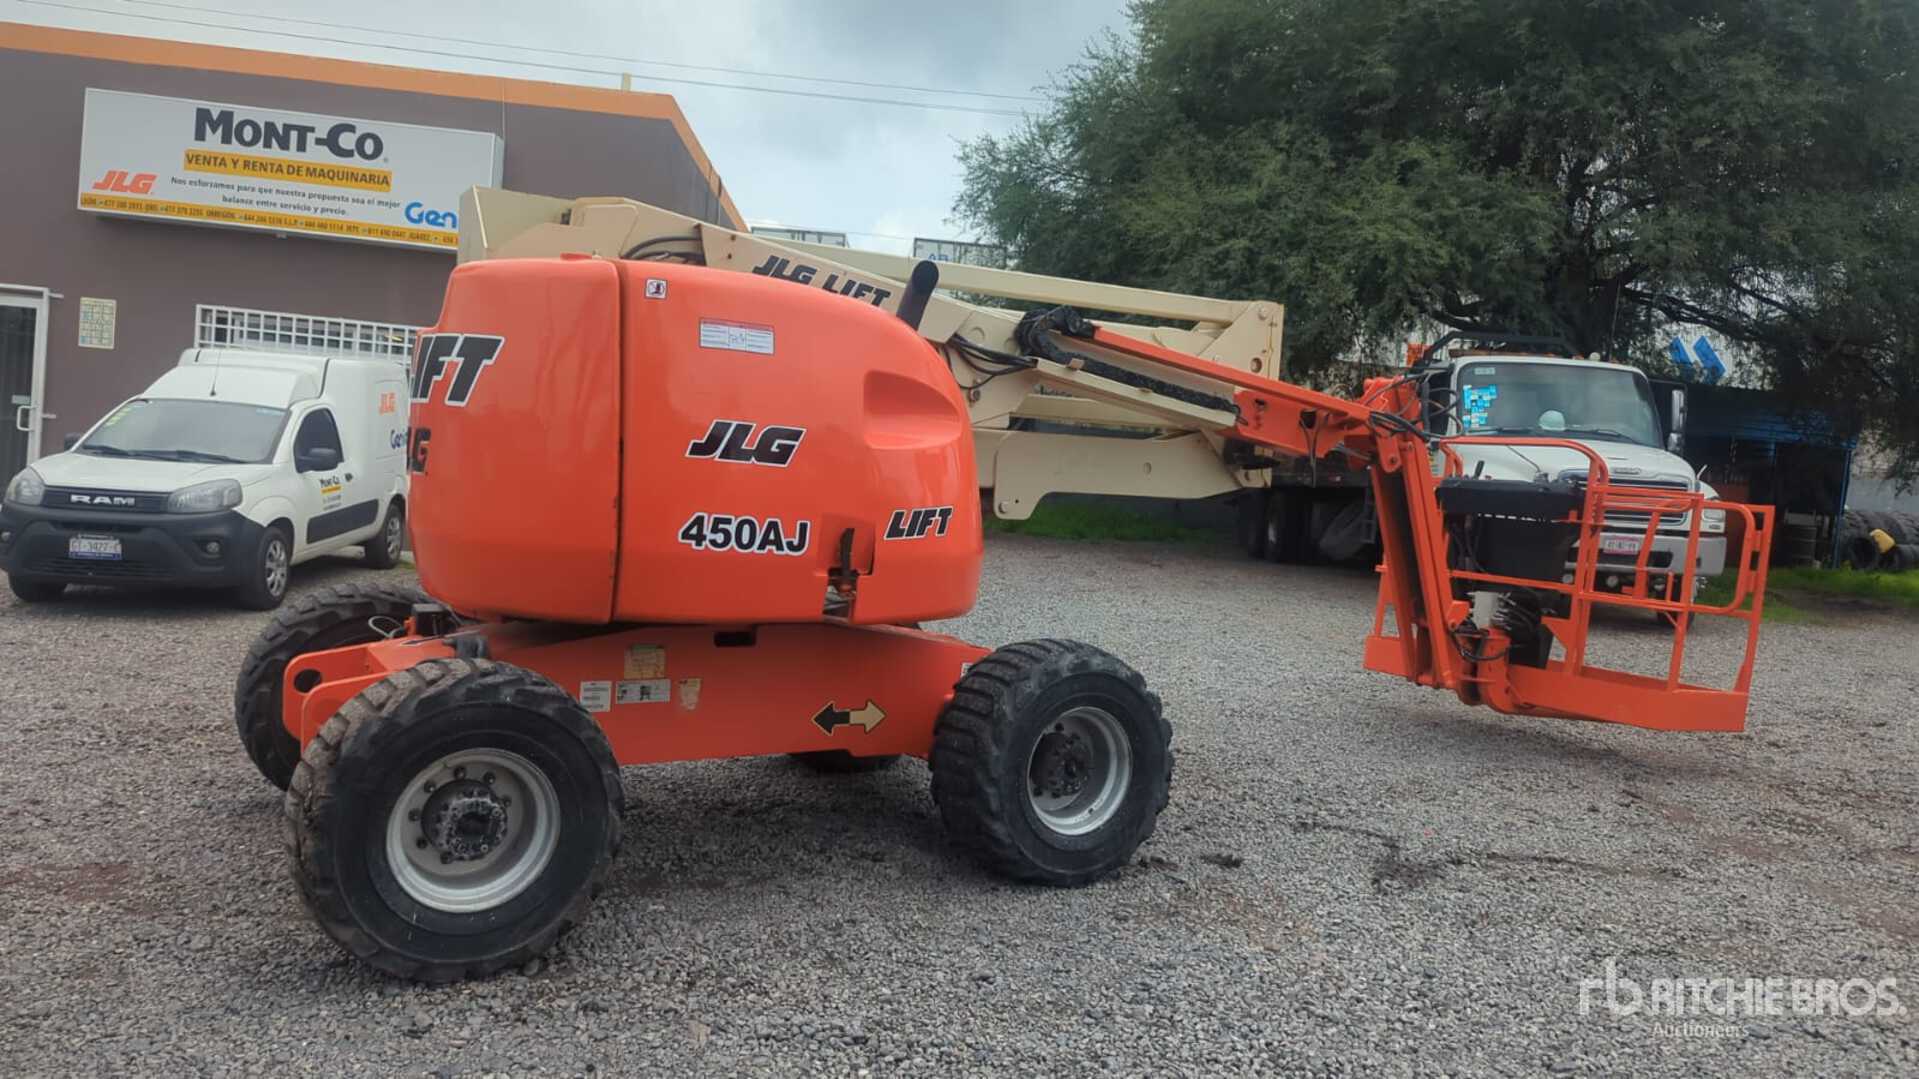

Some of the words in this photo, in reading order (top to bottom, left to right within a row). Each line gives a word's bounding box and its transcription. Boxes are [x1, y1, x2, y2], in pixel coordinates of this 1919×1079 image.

[92, 170, 157, 194] JLG
[185, 152, 227, 169] VENTA
[231, 157, 240, 169] Y
[243, 159, 284, 175] RENTA
[287, 164, 304, 177] DE
[305, 166, 390, 187] MAQUINARIA
[171, 177, 186, 185] Nos
[189, 179, 234, 190] esforzamos
[237, 184, 255, 193] para
[258, 187, 272, 195] que
[275, 188, 306, 198] nuestra
[308, 192, 349, 203] propuesta
[352, 197, 365, 205] sea
[367, 197, 375, 206] el
[377, 199, 401, 209] mejor
[222, 194, 253, 205] balance
[256, 199, 277, 208] entre
[280, 201, 311, 212] servicio
[313, 206, 319, 214] y
[405, 201, 457, 229] Gen
[752, 255, 817, 285] JLG
[822, 273, 891, 306] LIFT
[410, 333, 506, 407] IFT
[686, 419, 806, 467] JLG
[70, 494, 135, 506] RAM
[679, 512, 811, 556] 450AJ
[883, 506, 953, 540] LIFT
